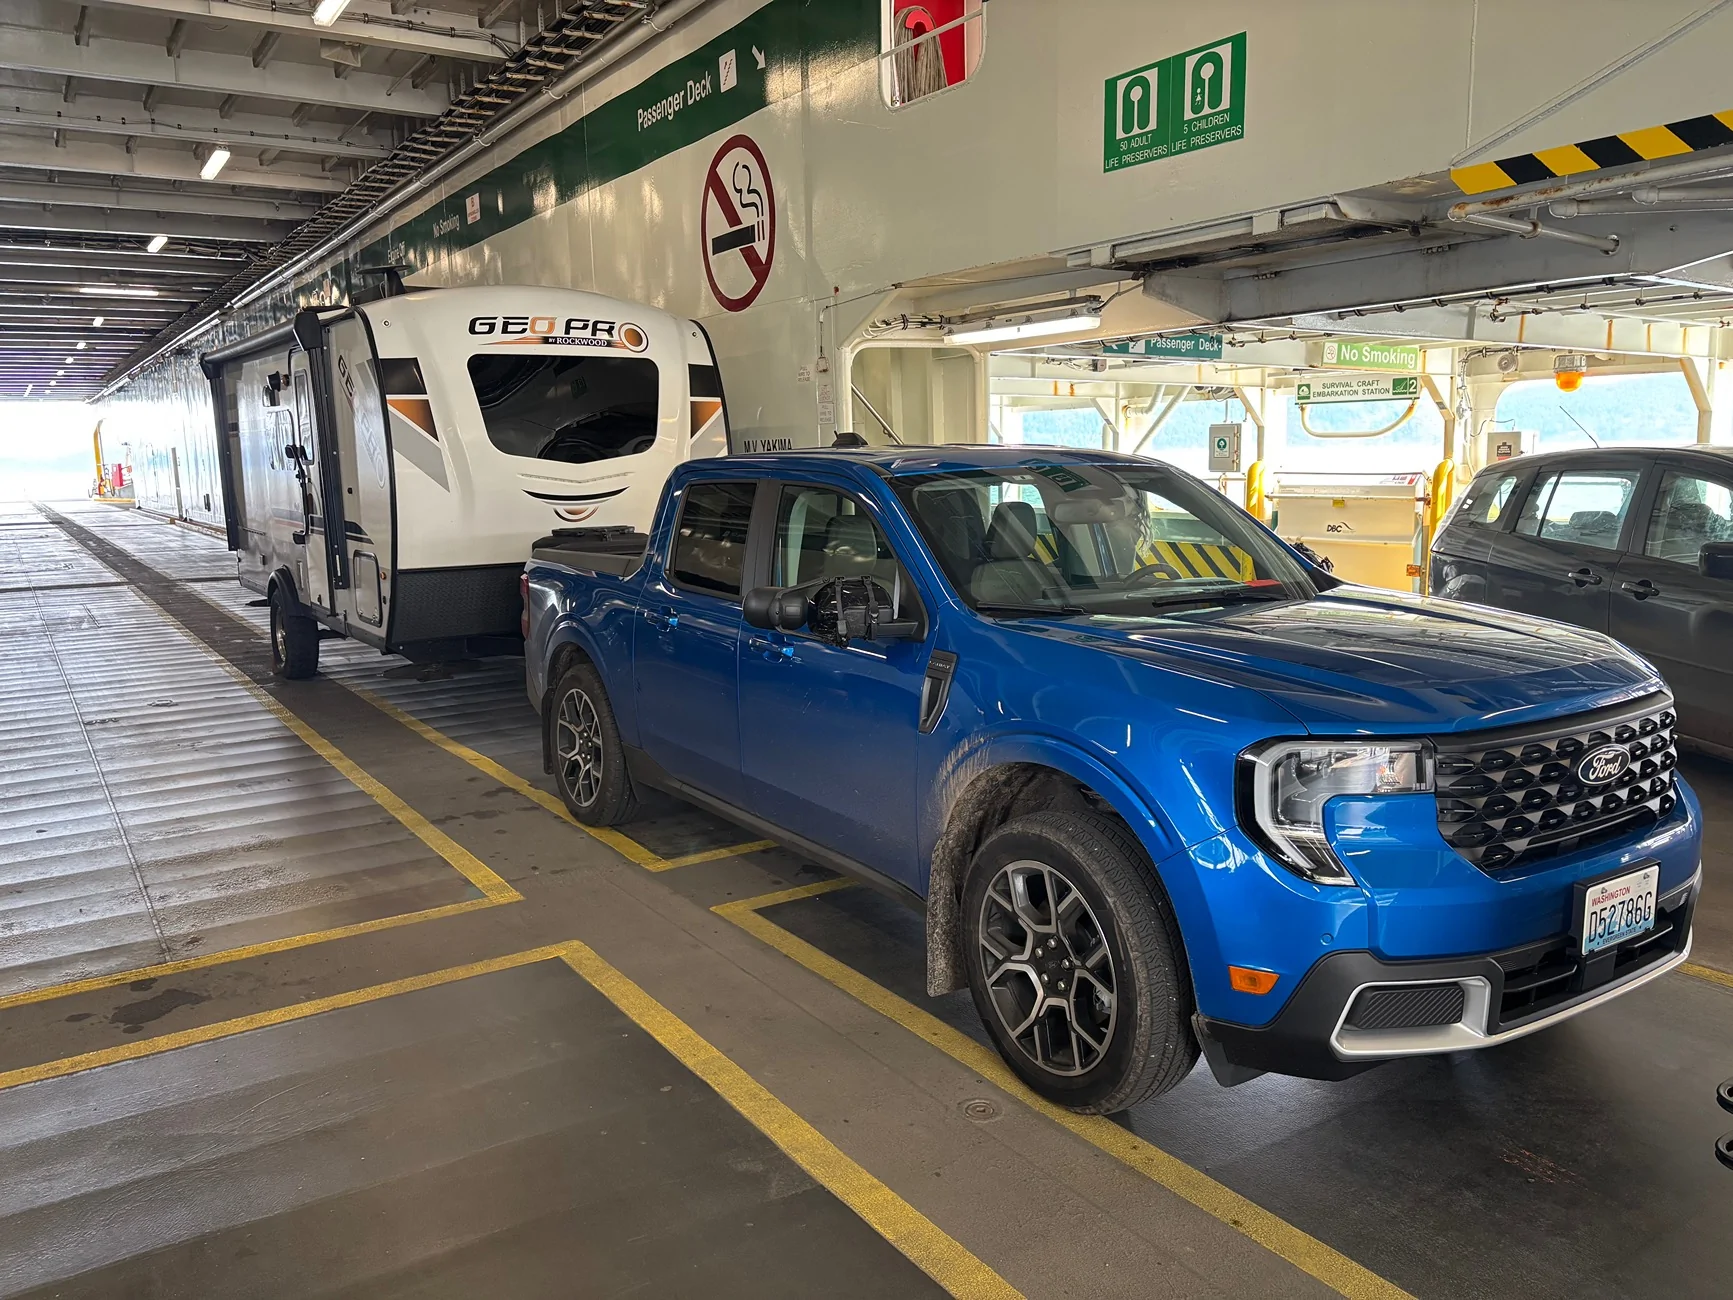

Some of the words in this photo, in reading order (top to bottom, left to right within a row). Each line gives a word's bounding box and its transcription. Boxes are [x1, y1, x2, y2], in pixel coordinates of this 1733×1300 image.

[637, 90, 684, 132] Passenger
[687, 70, 712, 105] Deck
[1183, 124, 1188, 134] 5
[1191, 112, 1230, 132] CHILDREN
[1120, 141, 1128, 151] 50
[1130, 134, 1152, 148] ADULT
[1171, 139, 1187, 152] LIFE
[1190, 125, 1242, 147] PRESERVERS
[1105, 157, 1119, 169] LIFE
[1122, 145, 1168, 164] PRESERVERS
[433, 222, 440, 238] No
[440, 214, 459, 235] Smoking
[468, 316, 557, 335] GEO
[564, 318, 649, 353] PRO
[556, 337, 607, 347] ROCKWOOD
[1150, 338, 1195, 352] Passenger
[1199, 338, 1219, 352] Deck
[1341, 345, 1358, 360] No
[1362, 346, 1415, 367] Smoking
[1312, 388, 1358, 398] EMBARKATION
[1362, 387, 1390, 395] STATION
[1322, 381, 1353, 389] SURVIVAL
[1356, 380, 1380, 388] CRAFT
[1409, 380, 1417, 392] 2
[760, 438, 793, 452] YAKIMA
[1589, 750, 1623, 780] Ford
[1592, 886, 1631, 907] WASHINGTON
[1589, 891, 1652, 943] D52786G
